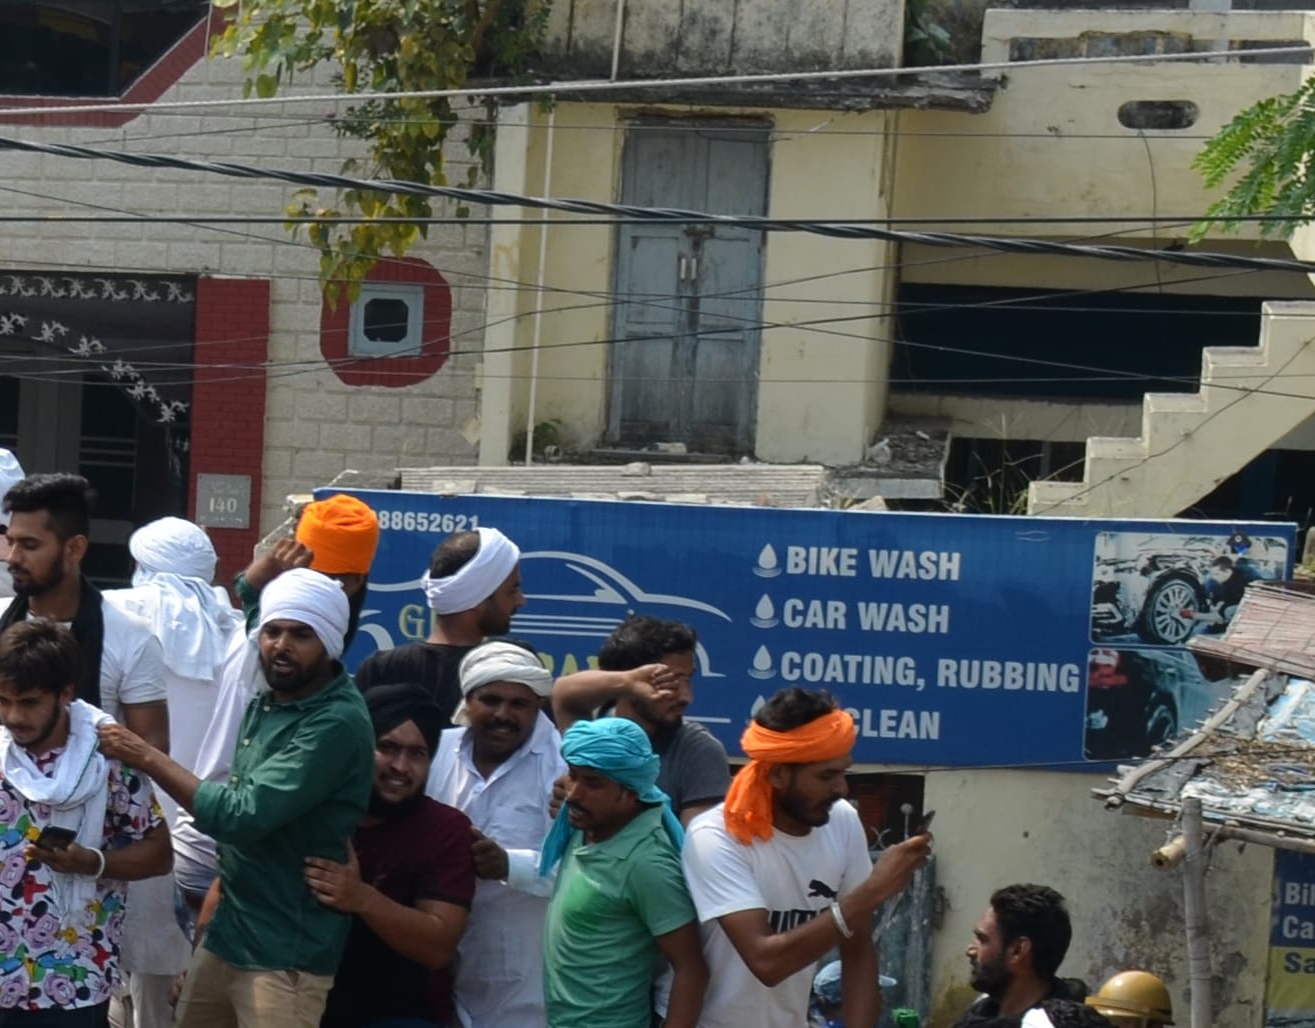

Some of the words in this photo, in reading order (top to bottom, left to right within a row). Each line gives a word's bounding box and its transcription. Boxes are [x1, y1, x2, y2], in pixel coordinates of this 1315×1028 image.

[209, 496, 238, 513] 140
[786, 545, 859, 577] BIKE
[868, 549, 961, 581] WASH
[782, 598, 847, 630] CAR
[857, 602, 950, 634] WASH
[780, 651, 926, 692] COATING,
[937, 658, 1081, 693] RUBBING
